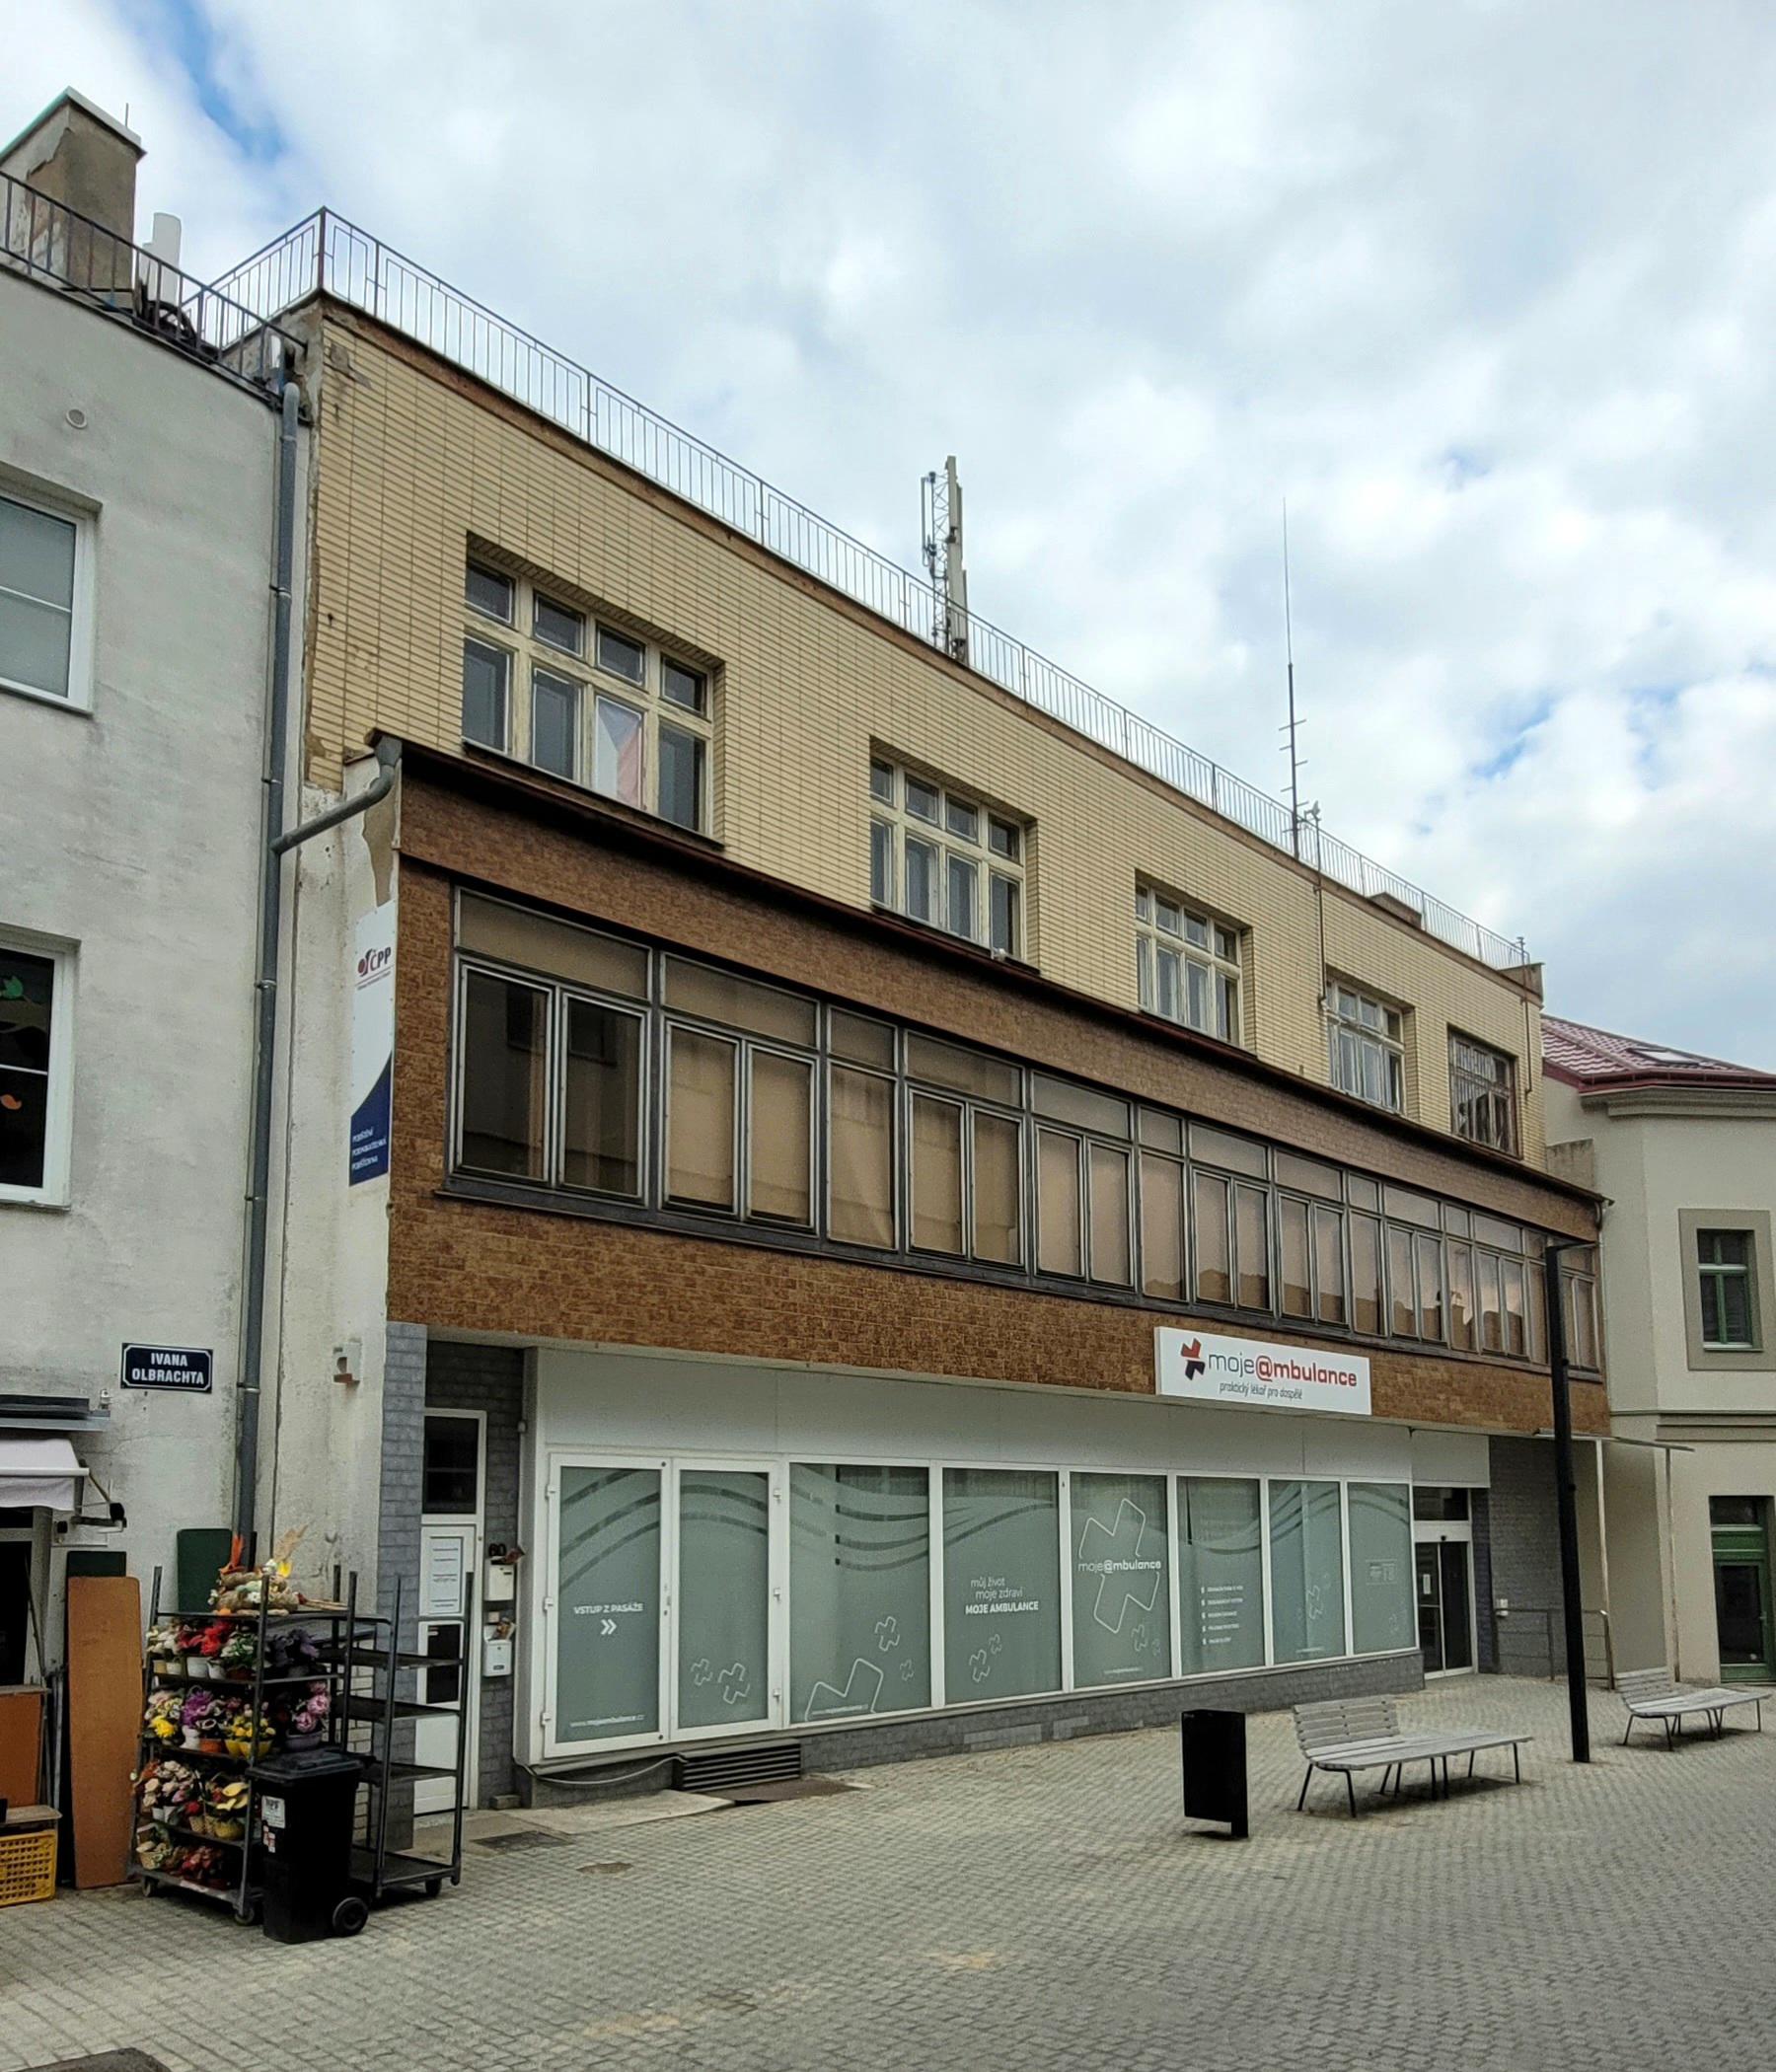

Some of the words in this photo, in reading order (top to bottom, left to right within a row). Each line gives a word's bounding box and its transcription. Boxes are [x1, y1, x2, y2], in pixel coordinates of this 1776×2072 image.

[151, 1352, 188, 1368] IVANA
[131, 1368, 204, 1385] OLBRACHTA
[1208, 1352, 1358, 1387] moje@mbulance
[1268, 1387, 1279, 1399] pro
[975, 1589, 998, 1601] moje
[573, 1605, 603, 1615] VSTUP
[603, 1604, 610, 1613] Z
[965, 1603, 989, 1615] MOJE
[990, 1600, 1039, 1613] AMBULANCE
